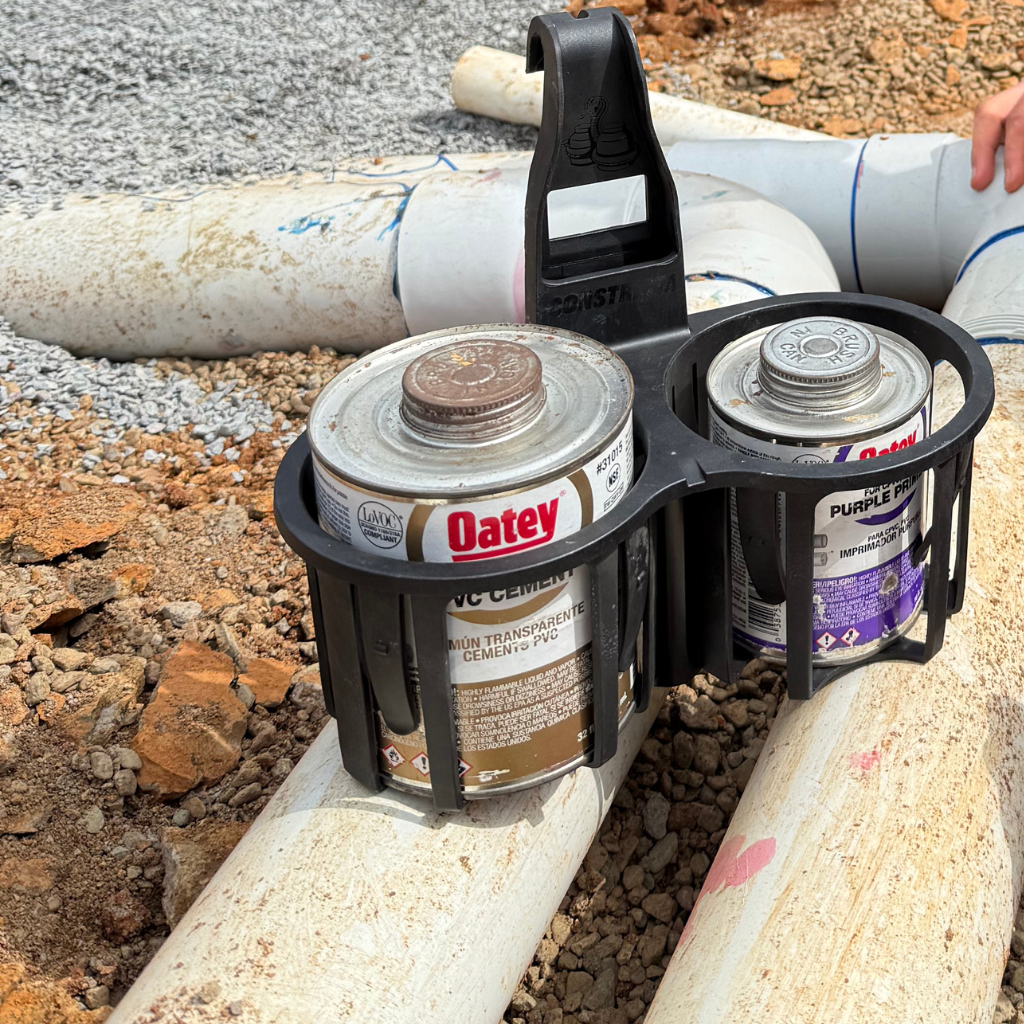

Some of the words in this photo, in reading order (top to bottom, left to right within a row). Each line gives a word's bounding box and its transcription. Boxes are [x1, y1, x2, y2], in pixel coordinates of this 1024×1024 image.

[790, 326, 813, 338] IN
[832, 326, 860, 365] BRUSH
[780, 343, 808, 364] CAN
[596, 439, 624, 476] #31015
[362, 506, 397, 528] LoVOC
[830, 490, 891, 518] PURPLE
[364, 528, 398, 543] COMPLIANT
[447, 496, 560, 563] Oatey
[868, 532, 884, 542] PARA
[840, 531, 897, 558] IMPRIMADOR
[453, 593, 482, 608] VC
[448, 636, 480, 650] MÚN
[484, 600, 585, 646] TRANSPARENTE
[533, 628, 558, 647] PVC
[461, 688, 483, 696] HIGHLY
[484, 678, 523, 693] FLAMMABLE
[525, 672, 544, 684] LIQUID
[545, 668, 557, 678] AND
[558, 658, 576, 672] VAPOR
[479, 691, 510, 701] HARMFUL
[556, 668, 568, 680] MAY
[462, 698, 504, 710] DROWSINESS
[516, 686, 546, 700] DIZZINESS
[551, 678, 564, 688] MAY
[514, 698, 526, 708] EPA
[526, 696, 535, 705] AS
[536, 694, 540, 702] A
[540, 680, 573, 700] SUSPECTED
[480, 712, 511, 723] PROVOCA
[480, 723, 526, 736] SOMNOLENCIA
[532, 710, 557, 724] MAREOS
[562, 700, 580, 712] PUEDE
[498, 718, 518, 727] PUEDE
[520, 714, 531, 722] SER
[550, 704, 556, 712] SI
[557, 700, 564, 709] SE
[464, 736, 494, 746] CONTIENE
[496, 733, 511, 741] UNA
[512, 722, 546, 738] SUSTANCIA
[478, 740, 506, 751] ESTADOS
[577, 729, 588, 742] 32
